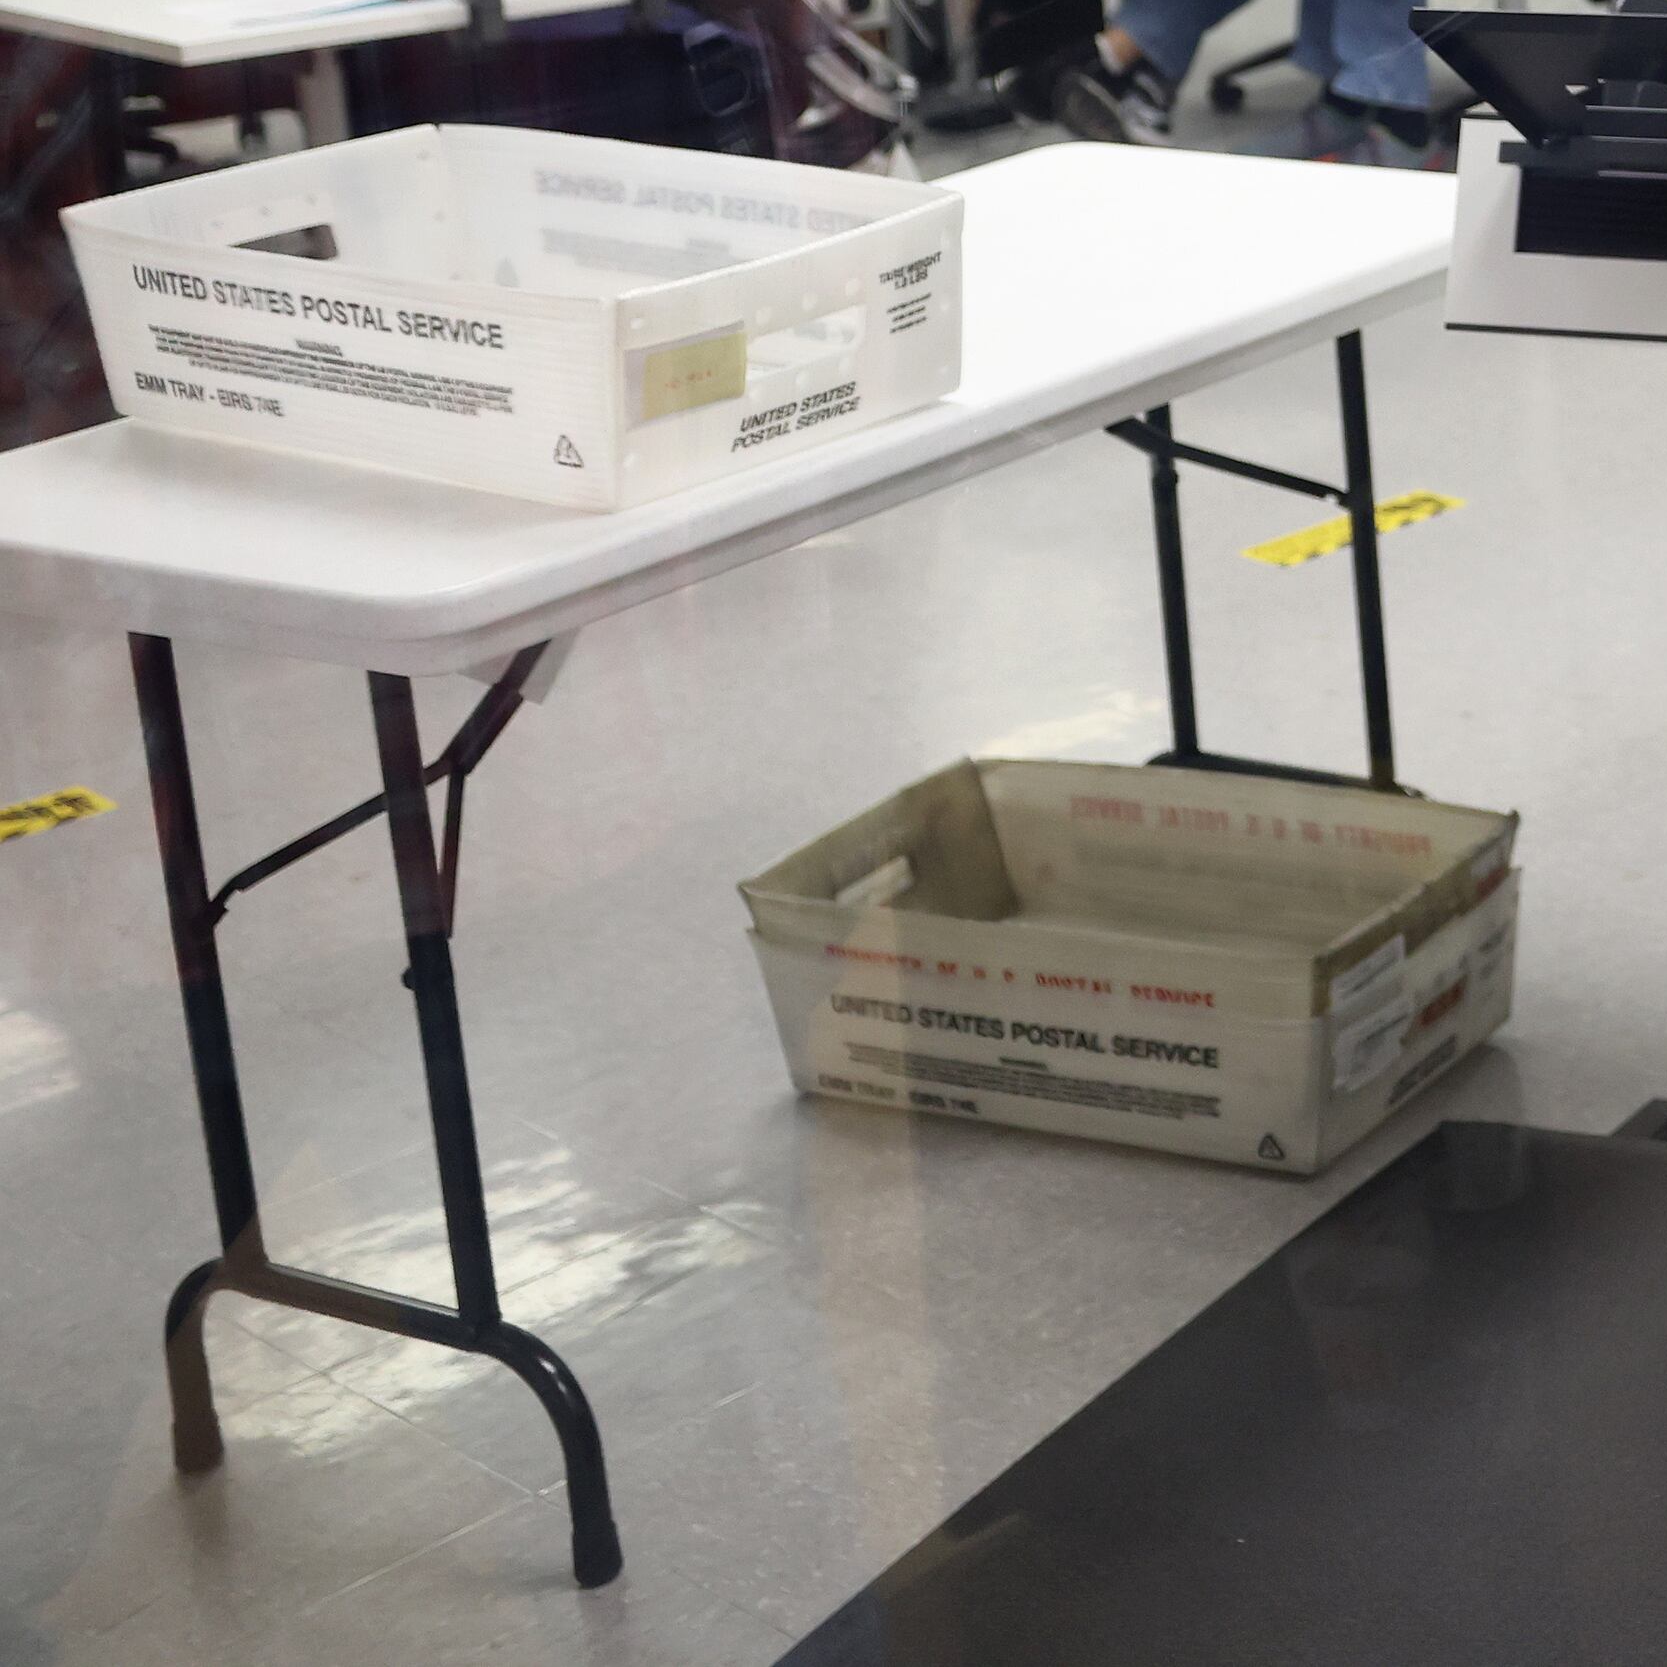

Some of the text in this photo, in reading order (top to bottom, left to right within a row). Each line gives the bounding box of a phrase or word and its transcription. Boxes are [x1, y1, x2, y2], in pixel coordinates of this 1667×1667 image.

[133, 265, 504, 350] UNITED STATES POSTAL SERVICE
[134, 372, 166, 394] EMM
[169, 380, 205, 402] TRAY
[740, 381, 856, 432] UNITED STATES
[731, 396, 861, 453] POSTAL SERVICE
[831, 993, 1219, 1069] UNITED STATES POSTAL SERVICE
